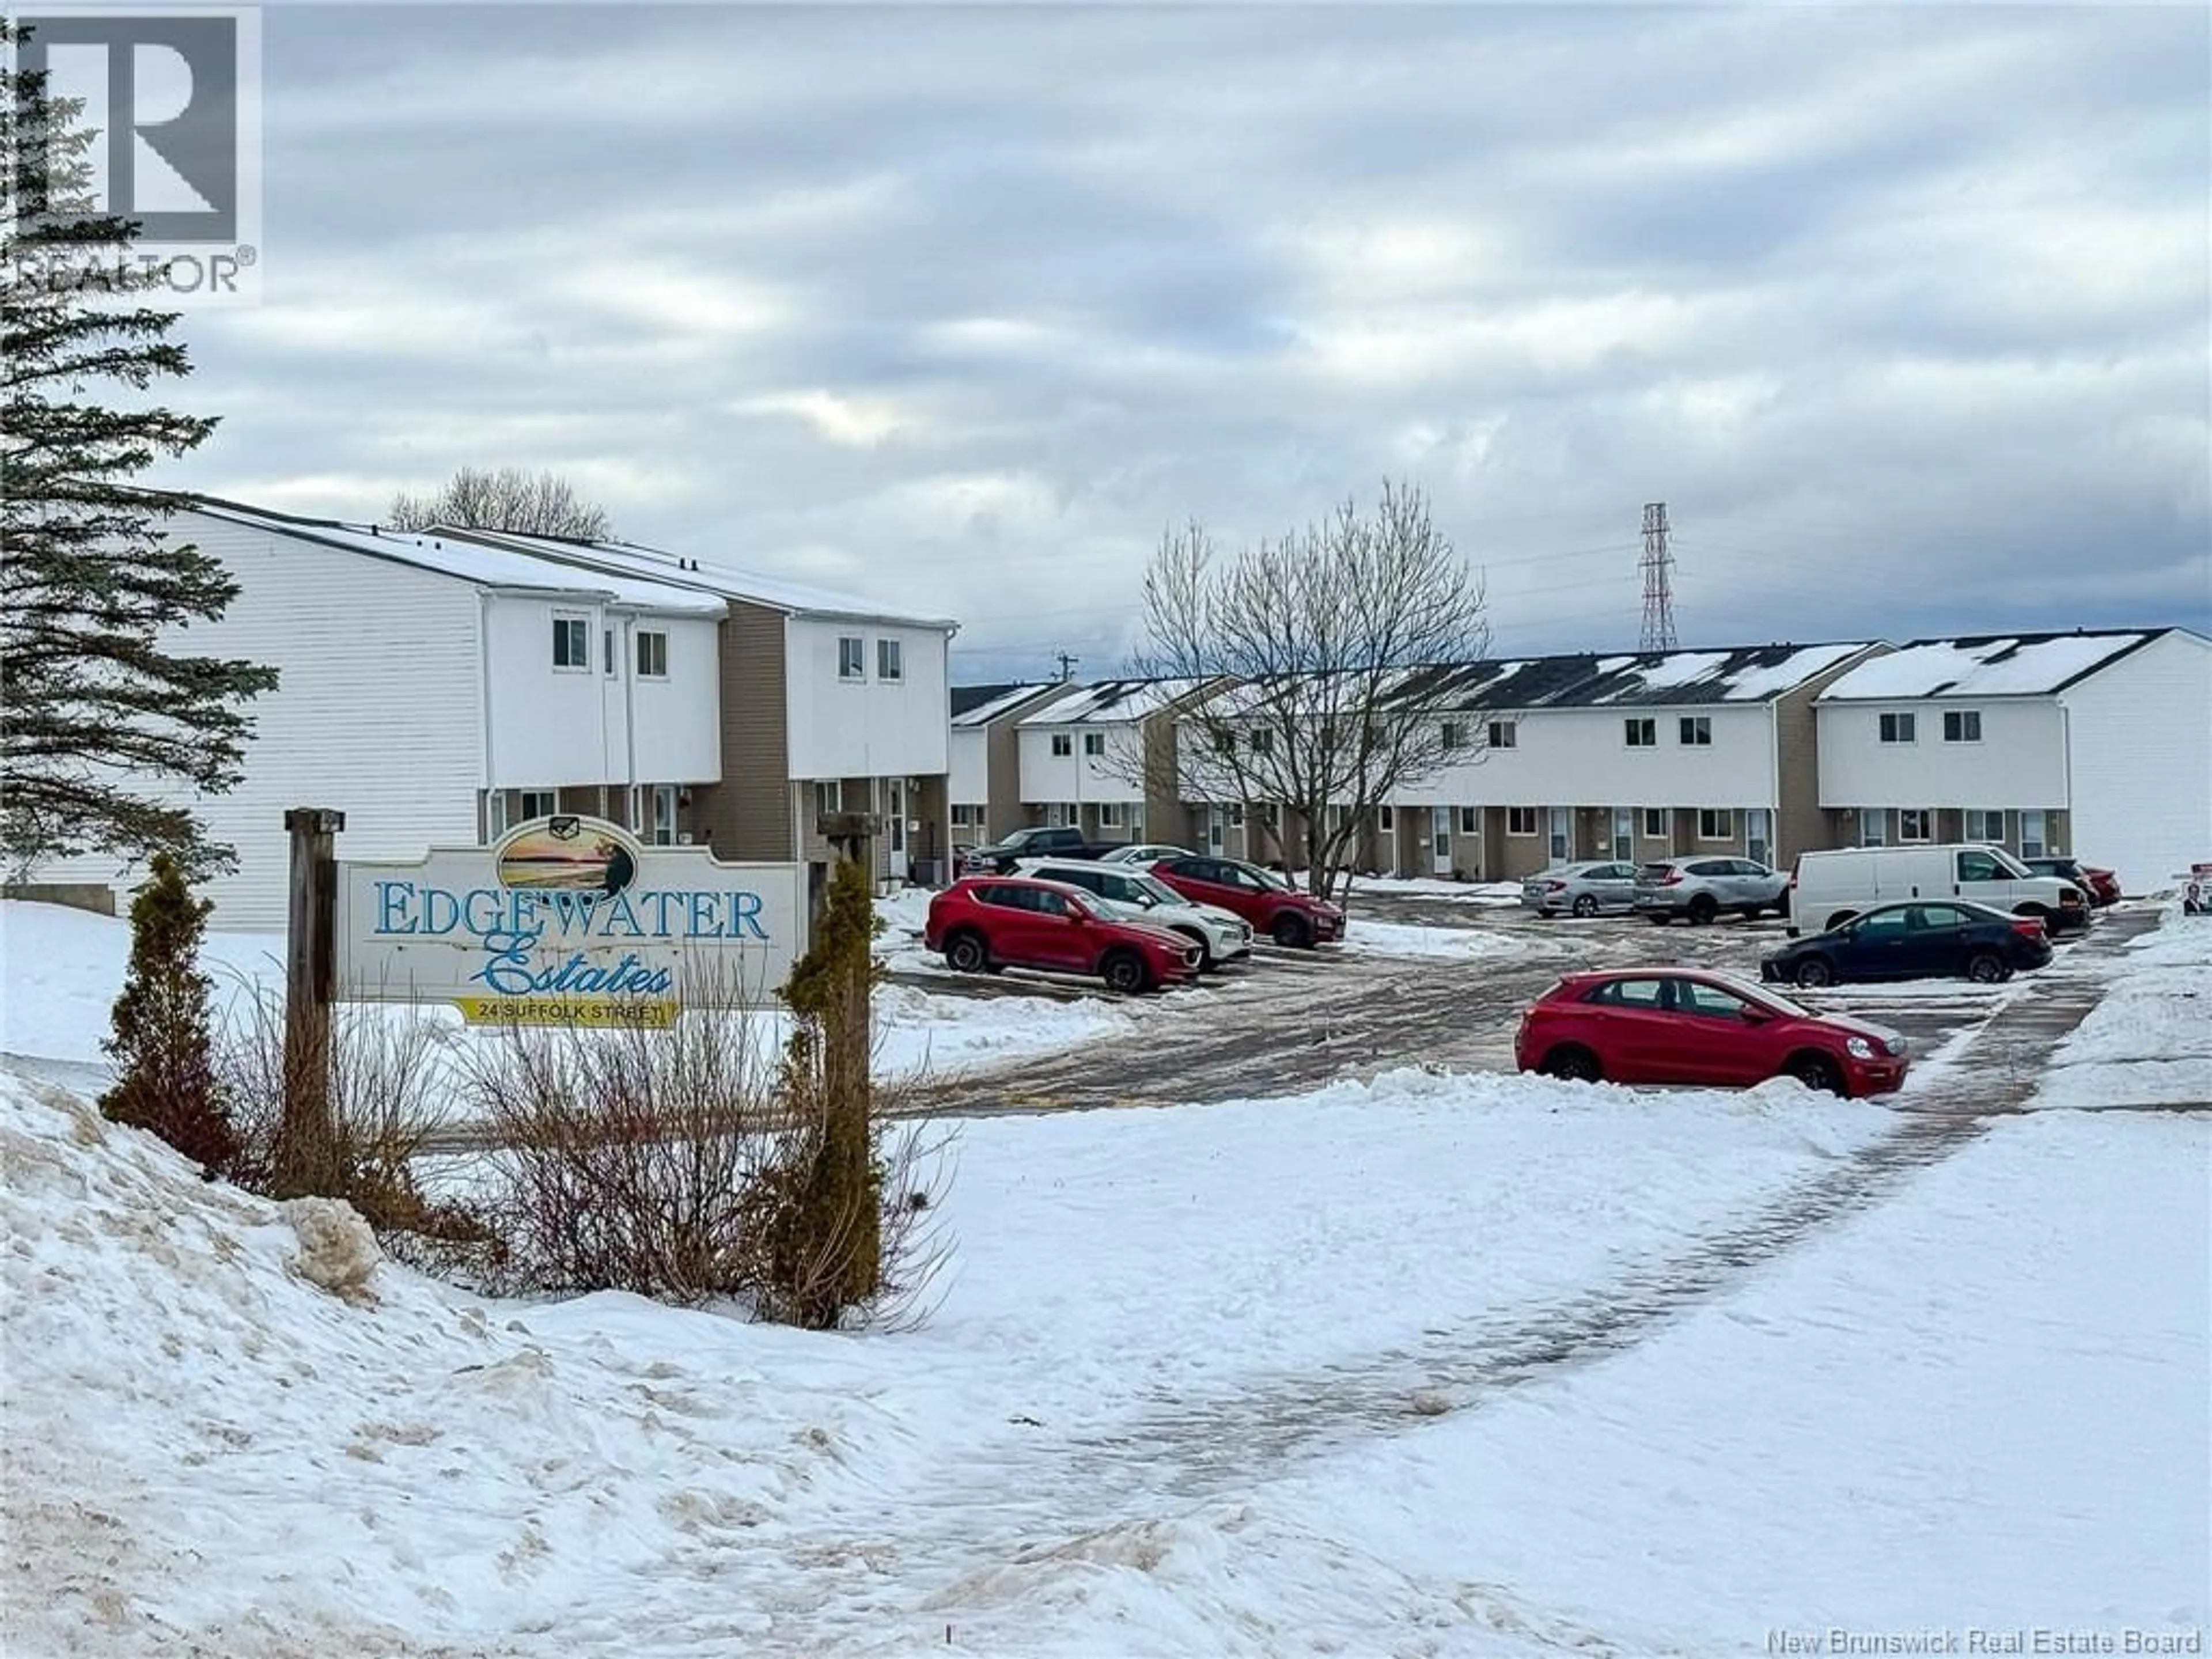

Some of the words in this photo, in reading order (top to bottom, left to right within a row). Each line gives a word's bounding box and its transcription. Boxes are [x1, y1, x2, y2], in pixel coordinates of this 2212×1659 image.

[374, 882, 770, 940] EDGEWATER
[469, 930, 672, 995] Estates
[479, 1003, 497, 1017] 24
[502, 1003, 585, 1018] SUFFOLK
[591, 1004, 662, 1020] STREET
